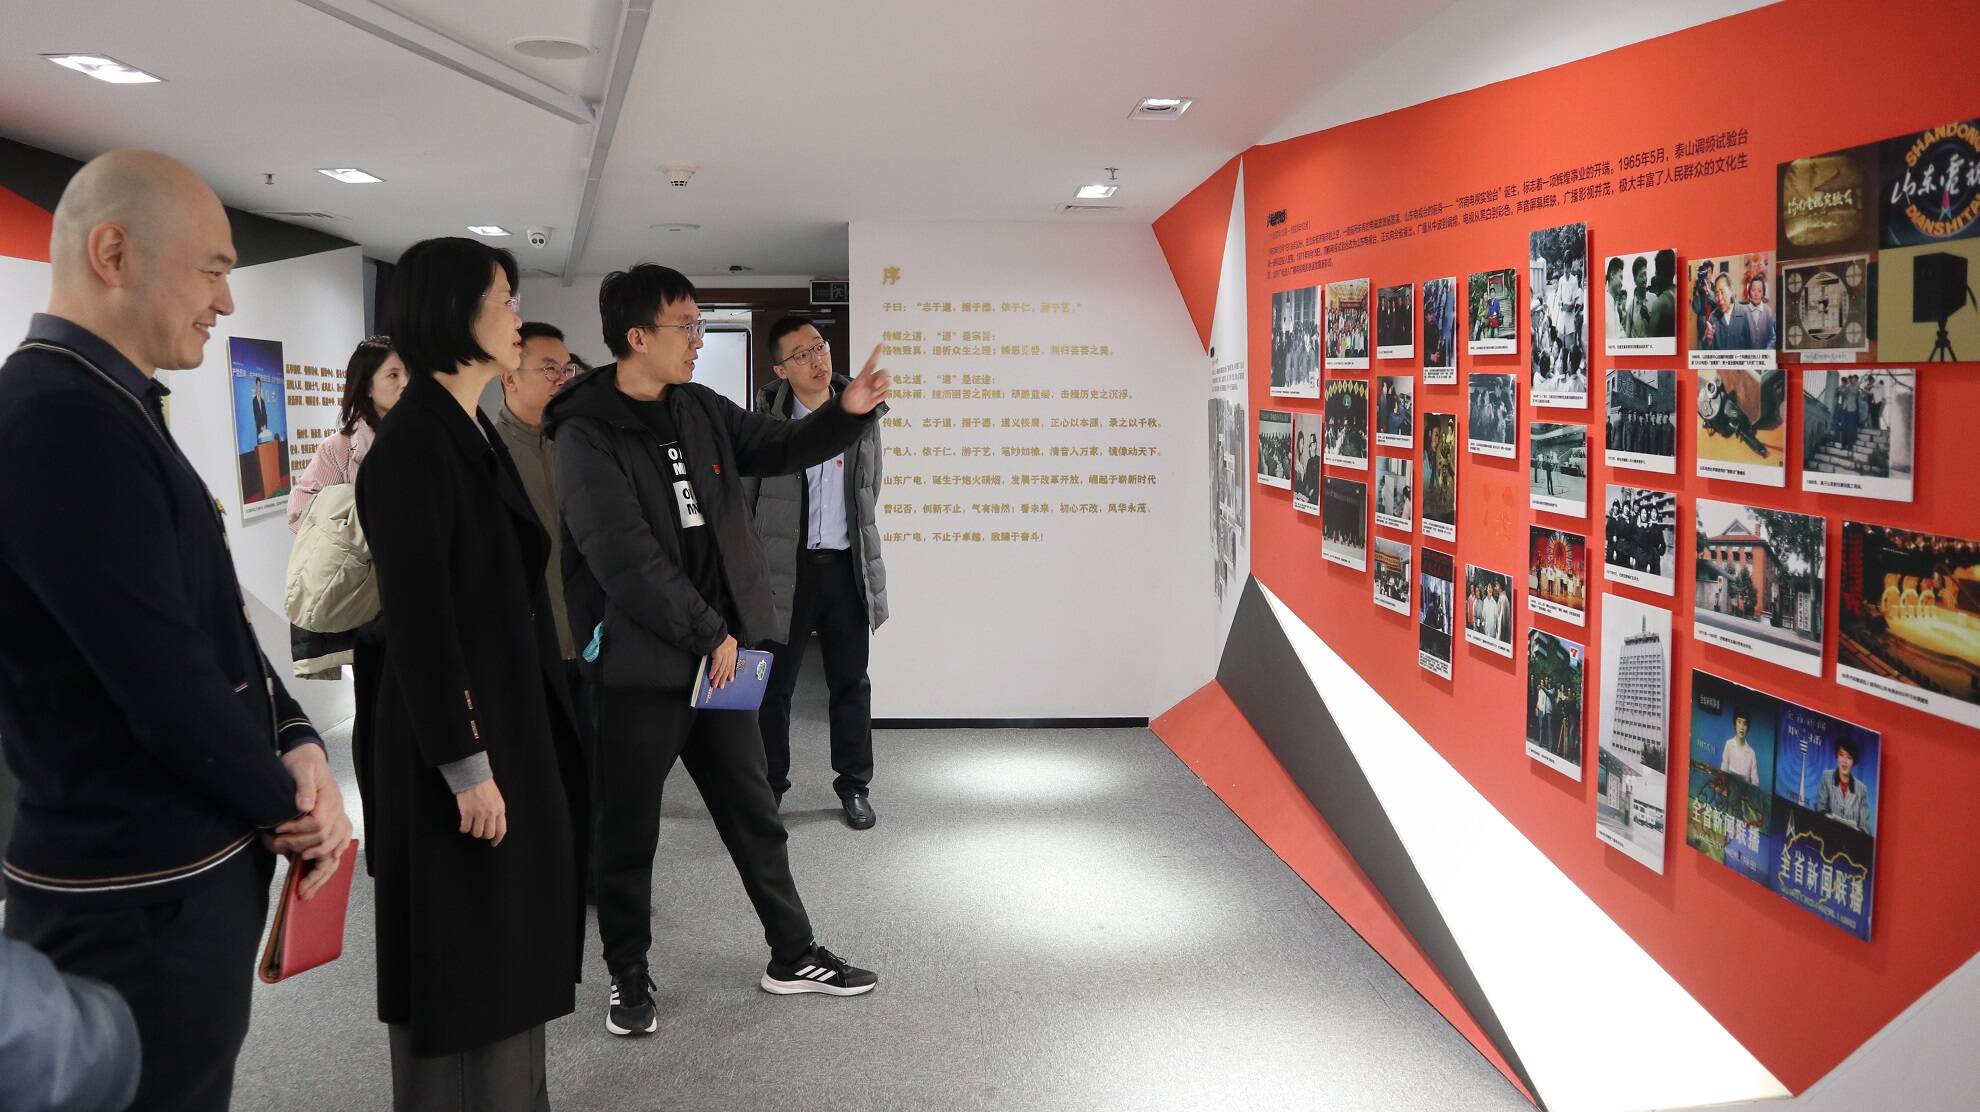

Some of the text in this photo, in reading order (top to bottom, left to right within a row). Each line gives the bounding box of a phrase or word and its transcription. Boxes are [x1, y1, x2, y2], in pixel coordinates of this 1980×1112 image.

[881, 265, 902, 286] 序
[1780, 843, 1864, 916] 全省新闻联播
